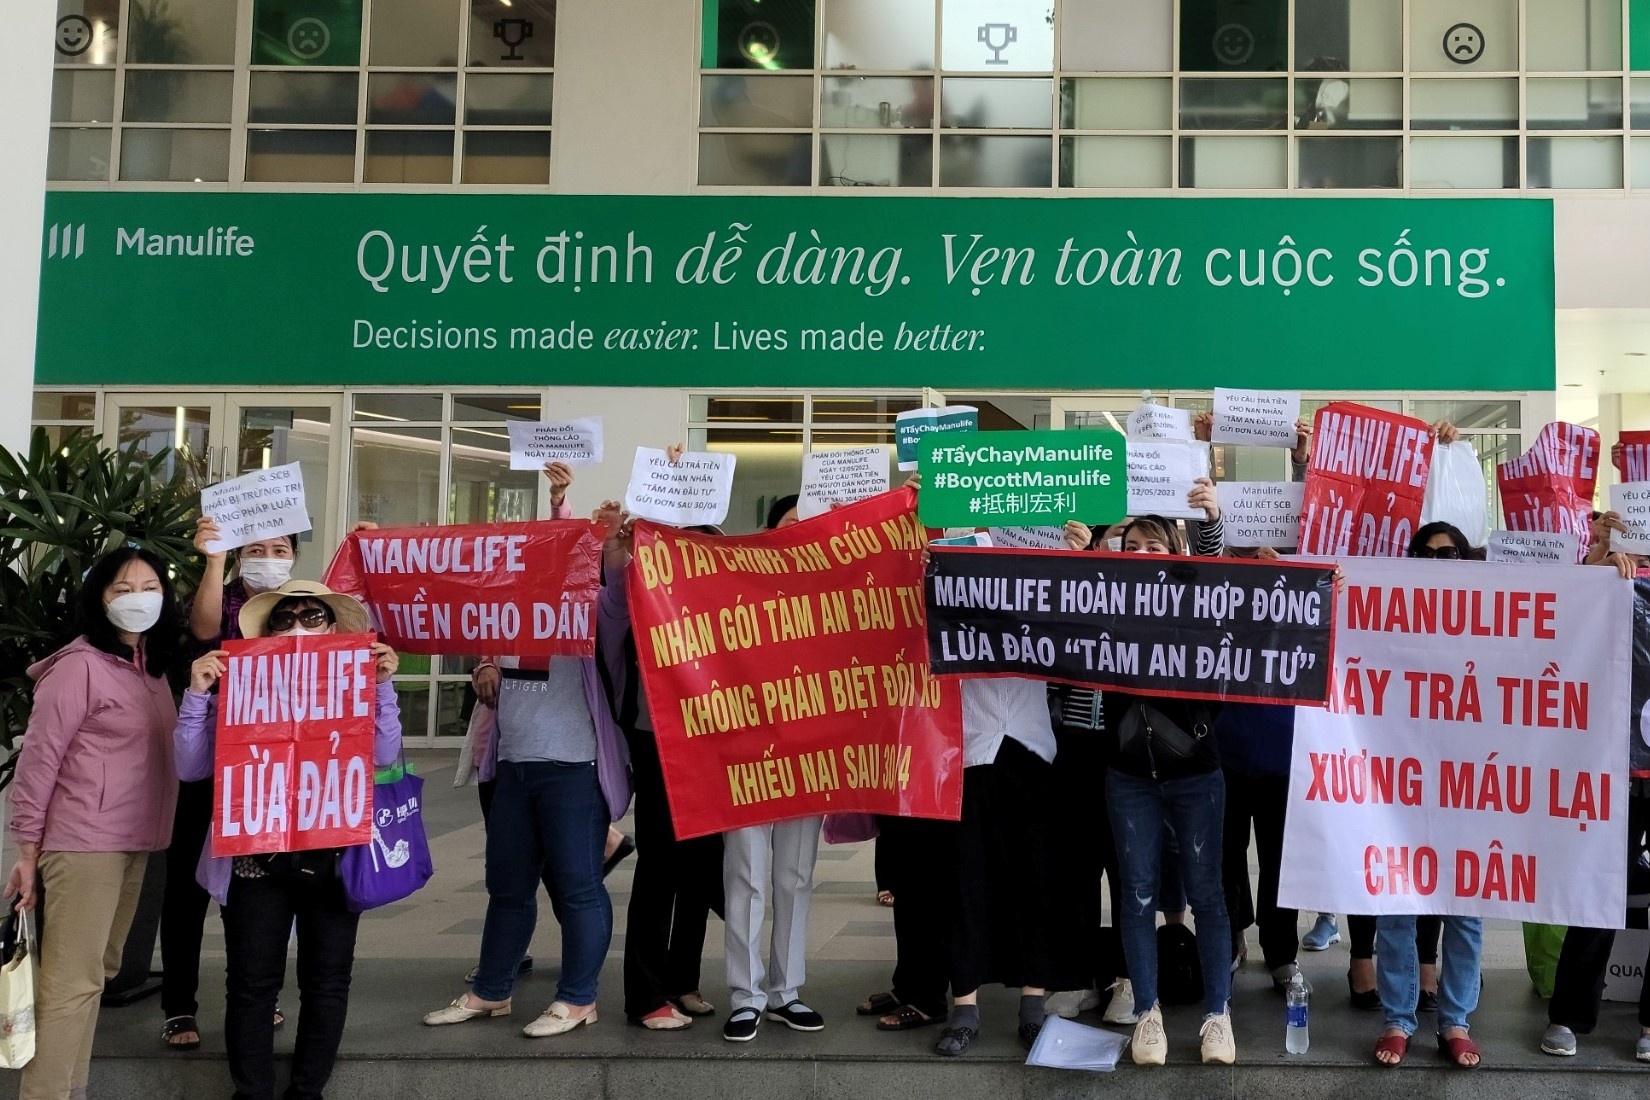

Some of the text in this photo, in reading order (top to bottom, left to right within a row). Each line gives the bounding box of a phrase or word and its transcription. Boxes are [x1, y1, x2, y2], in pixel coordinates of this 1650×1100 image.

[116, 226, 255, 256] Manulife
[357, 222, 1506, 298] Quyết định dễ dàng. Vẹn toàn cuộc sống.
[353, 319, 985, 351] Decisions made easier. Lives made better.
[1269, 430, 1289, 438] 30/04
[524, 449, 591, 459] NGÀY 12/05/2023
[931, 445, 1113, 466] #TẩyChayManulife
[1314, 411, 1429, 488] MANULIFE
[1503, 422, 1596, 482] MANULIFE
[270, 470, 291, 480] SCB
[651, 471, 669, 481] CHO
[934, 469, 1111, 492] #BoycottManulife
[1131, 475, 1172, 484] MANULIFE
[668, 487, 681, 496] AN
[676, 501, 693, 509] SAU
[694, 500, 718, 511] 30/04
[969, 491, 1076, 515] #抵制宏利
[1132, 488, 1176, 497] 12/05/2023
[1242, 486, 1283, 495] Manulife
[1273, 500, 1291, 509] SCB
[257, 517, 285, 532] NAM
[1224, 511, 1244, 523] LỪA
[1269, 511, 1300, 524] CHIẾM
[1301, 489, 1412, 558] LỪA ĐẢO
[1627, 505, 1646, 514] CHO
[1237, 526, 1287, 540] ĐOẠT TIỀN
[359, 534, 527, 574] MANULIFE
[638, 530, 674, 595] BỘ
[785, 543, 831, 573] XIN
[829, 521, 882, 566] CỨU
[881, 511, 928, 561] NẠN
[388, 587, 451, 640] TIỀN
[461, 602, 520, 640] CHO
[533, 591, 590, 640] DÂN
[935, 570, 1321, 629] MANULIFE HOÀN HỦY HỢP ĐỒNG
[1347, 585, 1557, 640] MANULIFE
[650, 606, 715, 670] NHẬN
[719, 594, 762, 651] GÓI
[763, 590, 817, 643] TÂM
[819, 588, 851, 635] AN
[852, 571, 896, 632] ĐẦU
[941, 623, 1317, 686] LỪA ĐẢO “TÂM AN ĐẦU TƯ”
[226, 649, 370, 727] MANULIFE
[504, 681, 548, 692] LFIGER
[679, 648, 915, 739] KHÔNG PHÂN BIỆT ĐỐI
[1326, 656, 1589, 731] ÃY TRẢ TIỀN
[222, 730, 366, 837] LỪA ĐẢO
[726, 743, 913, 807] KHIẾU NẠI SAU 30/4
[1305, 747, 1611, 832] XƯƠNG MÁU LẠI
[1364, 839, 1537, 904] CHO DÂN
[1609, 964, 1644, 978] QUA
